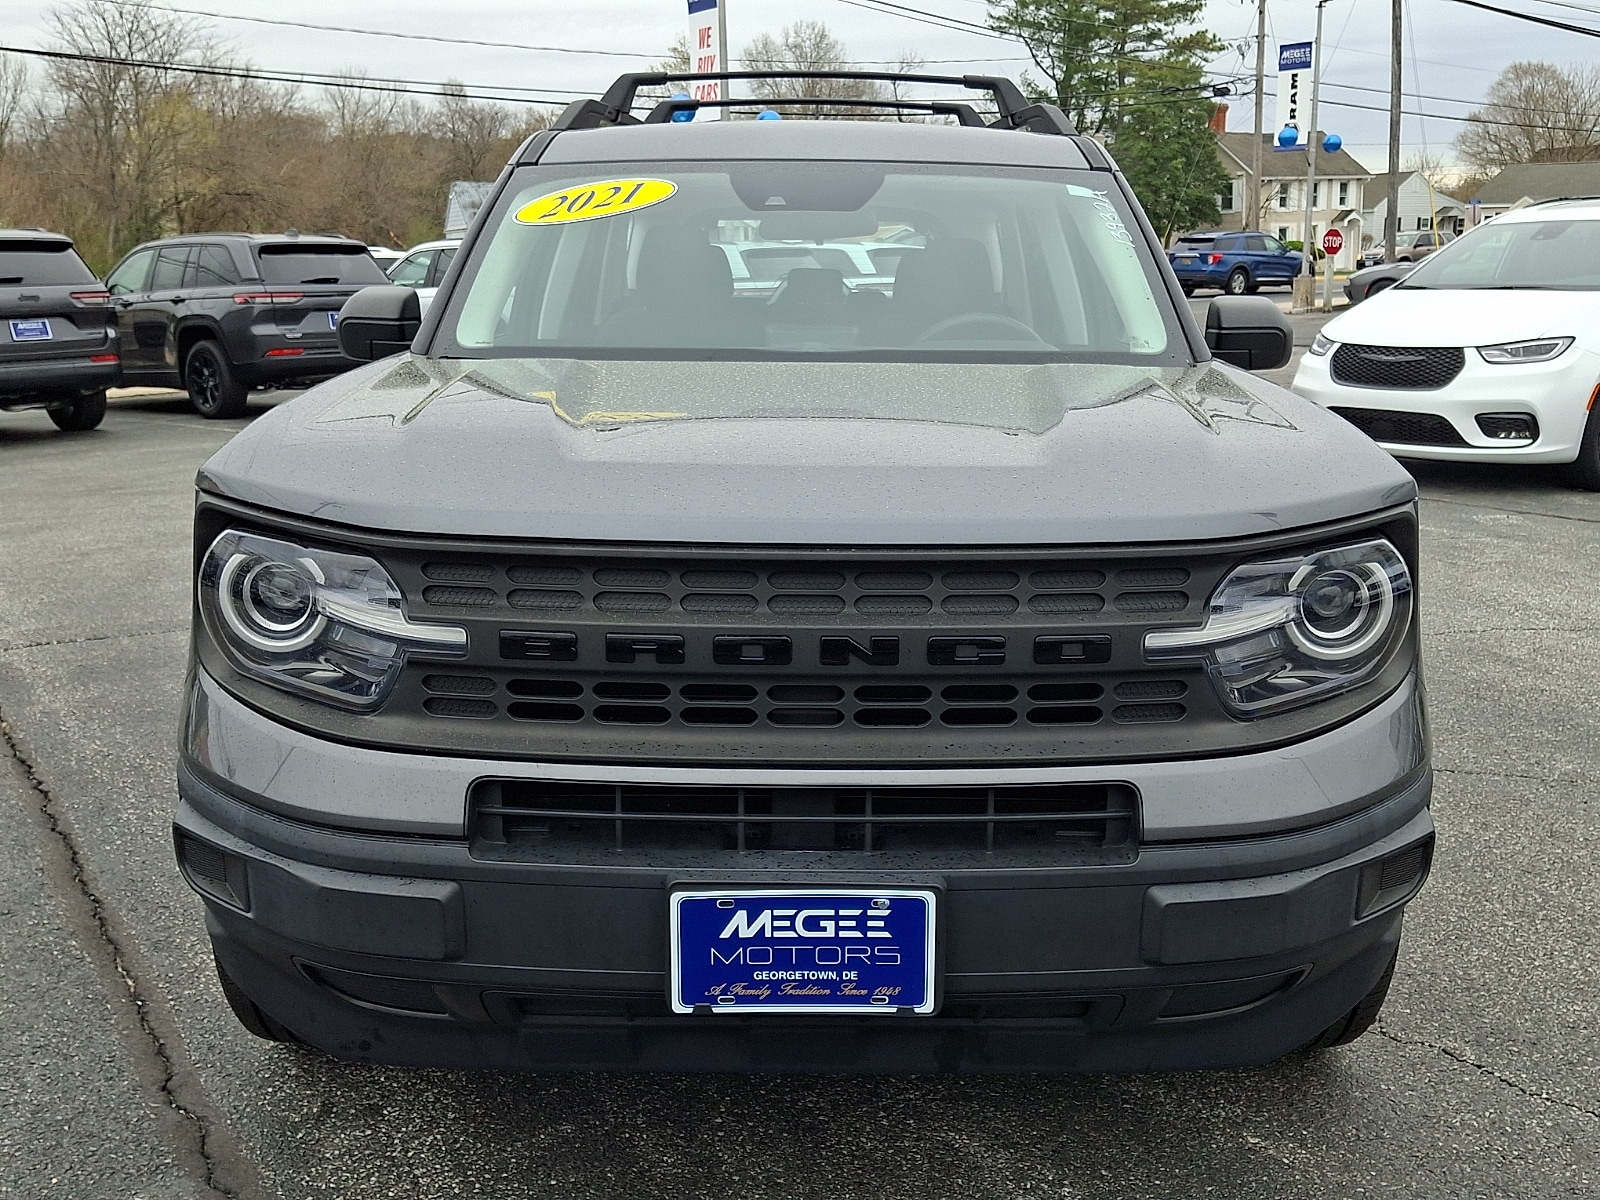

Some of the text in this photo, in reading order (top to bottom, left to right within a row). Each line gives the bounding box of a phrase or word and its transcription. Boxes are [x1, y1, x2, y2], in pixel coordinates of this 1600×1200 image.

[698, 26, 712, 50] WE
[1280, 57, 1311, 65] MOTORS
[1281, 48, 1311, 58] MEGEE
[698, 54, 716, 73] BUY
[695, 83, 719, 101] CARS
[1289, 73, 1299, 120] RAM
[538, 182, 645, 220] 2021
[1323, 236, 1343, 248] STOP
[499, 629, 1112, 666] BRONCO
[719, 909, 892, 938] MEGEE
[710, 946, 901, 965] MOTORS
[753, 971, 858, 981] GEORGETOWN, DE
[705, 983, 902, 1000] A Family Tradition Since 1948
